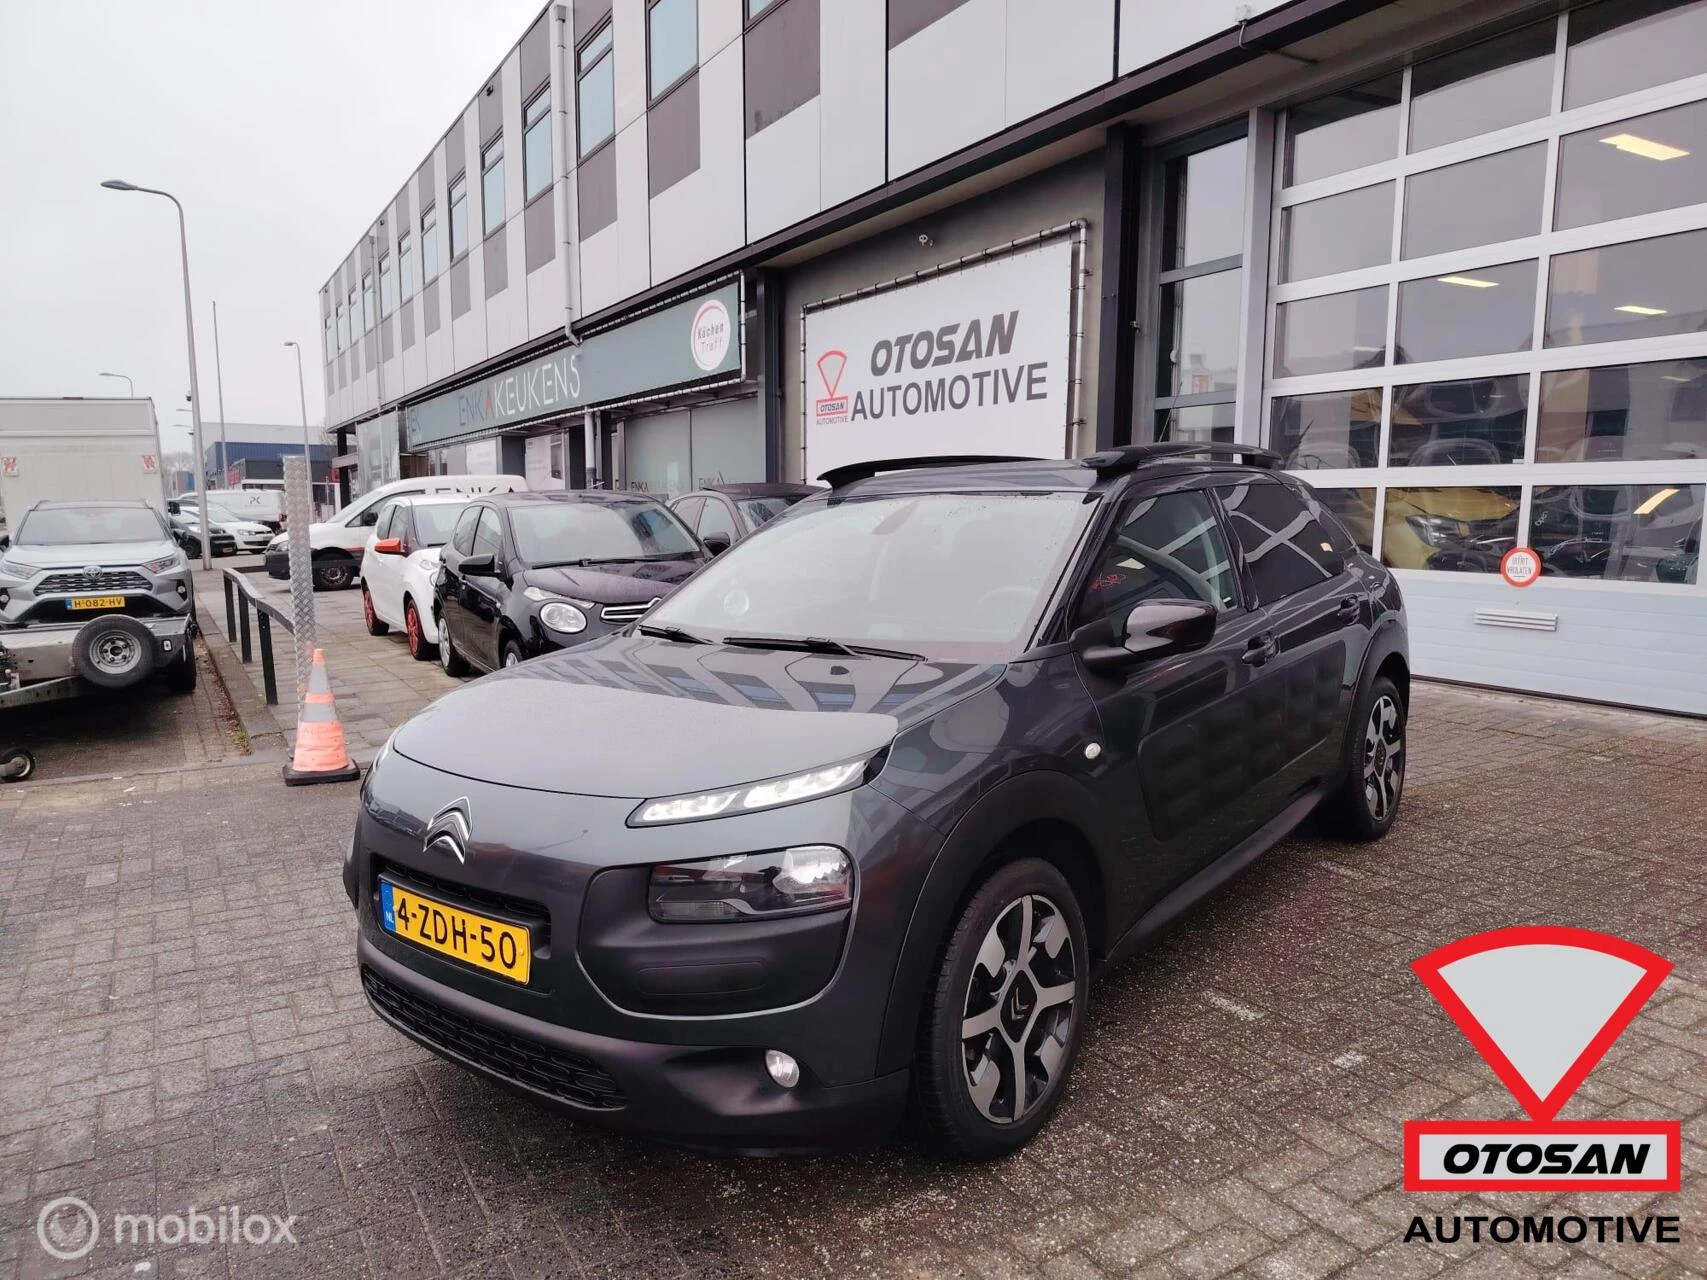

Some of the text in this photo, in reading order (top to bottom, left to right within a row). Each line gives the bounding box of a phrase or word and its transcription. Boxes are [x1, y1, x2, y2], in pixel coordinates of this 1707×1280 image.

[870, 310, 1019, 377] OTOSAN
[494, 353, 581, 420] KEUKENS
[820, 402, 845, 413] OTOSAN
[851, 361, 1048, 422] AUTOMOTIVE
[815, 416, 849, 425] AUTOMOTIVE
[397, 897, 517, 969] 4-ZDH-50
